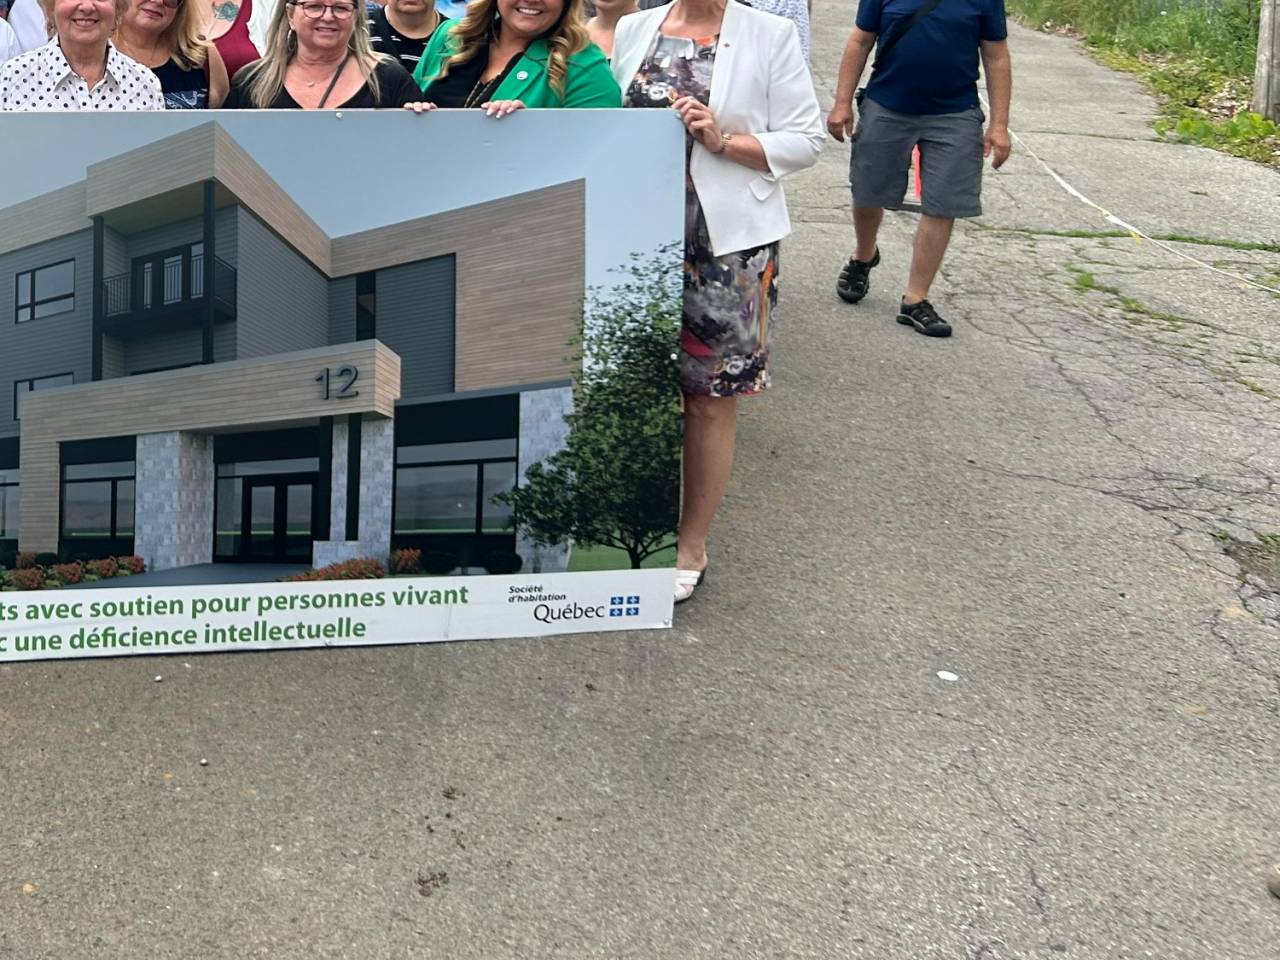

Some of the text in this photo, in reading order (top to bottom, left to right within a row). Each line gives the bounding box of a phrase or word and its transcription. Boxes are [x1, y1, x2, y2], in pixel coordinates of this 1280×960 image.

[315, 364, 360, 400] 12
[25, 601, 83, 620] avec
[90, 594, 184, 617] soutien
[191, 595, 251, 619] pour
[257, 589, 386, 616] personnes
[392, 585, 469, 607] vivant
[508, 584, 544, 594] Société
[508, 593, 567, 604] d'habitation
[533, 602, 606, 624] Québec
[14, 632, 63, 652] une
[69, 626, 198, 650] déficience
[204, 617, 367, 644] intellectuelle
